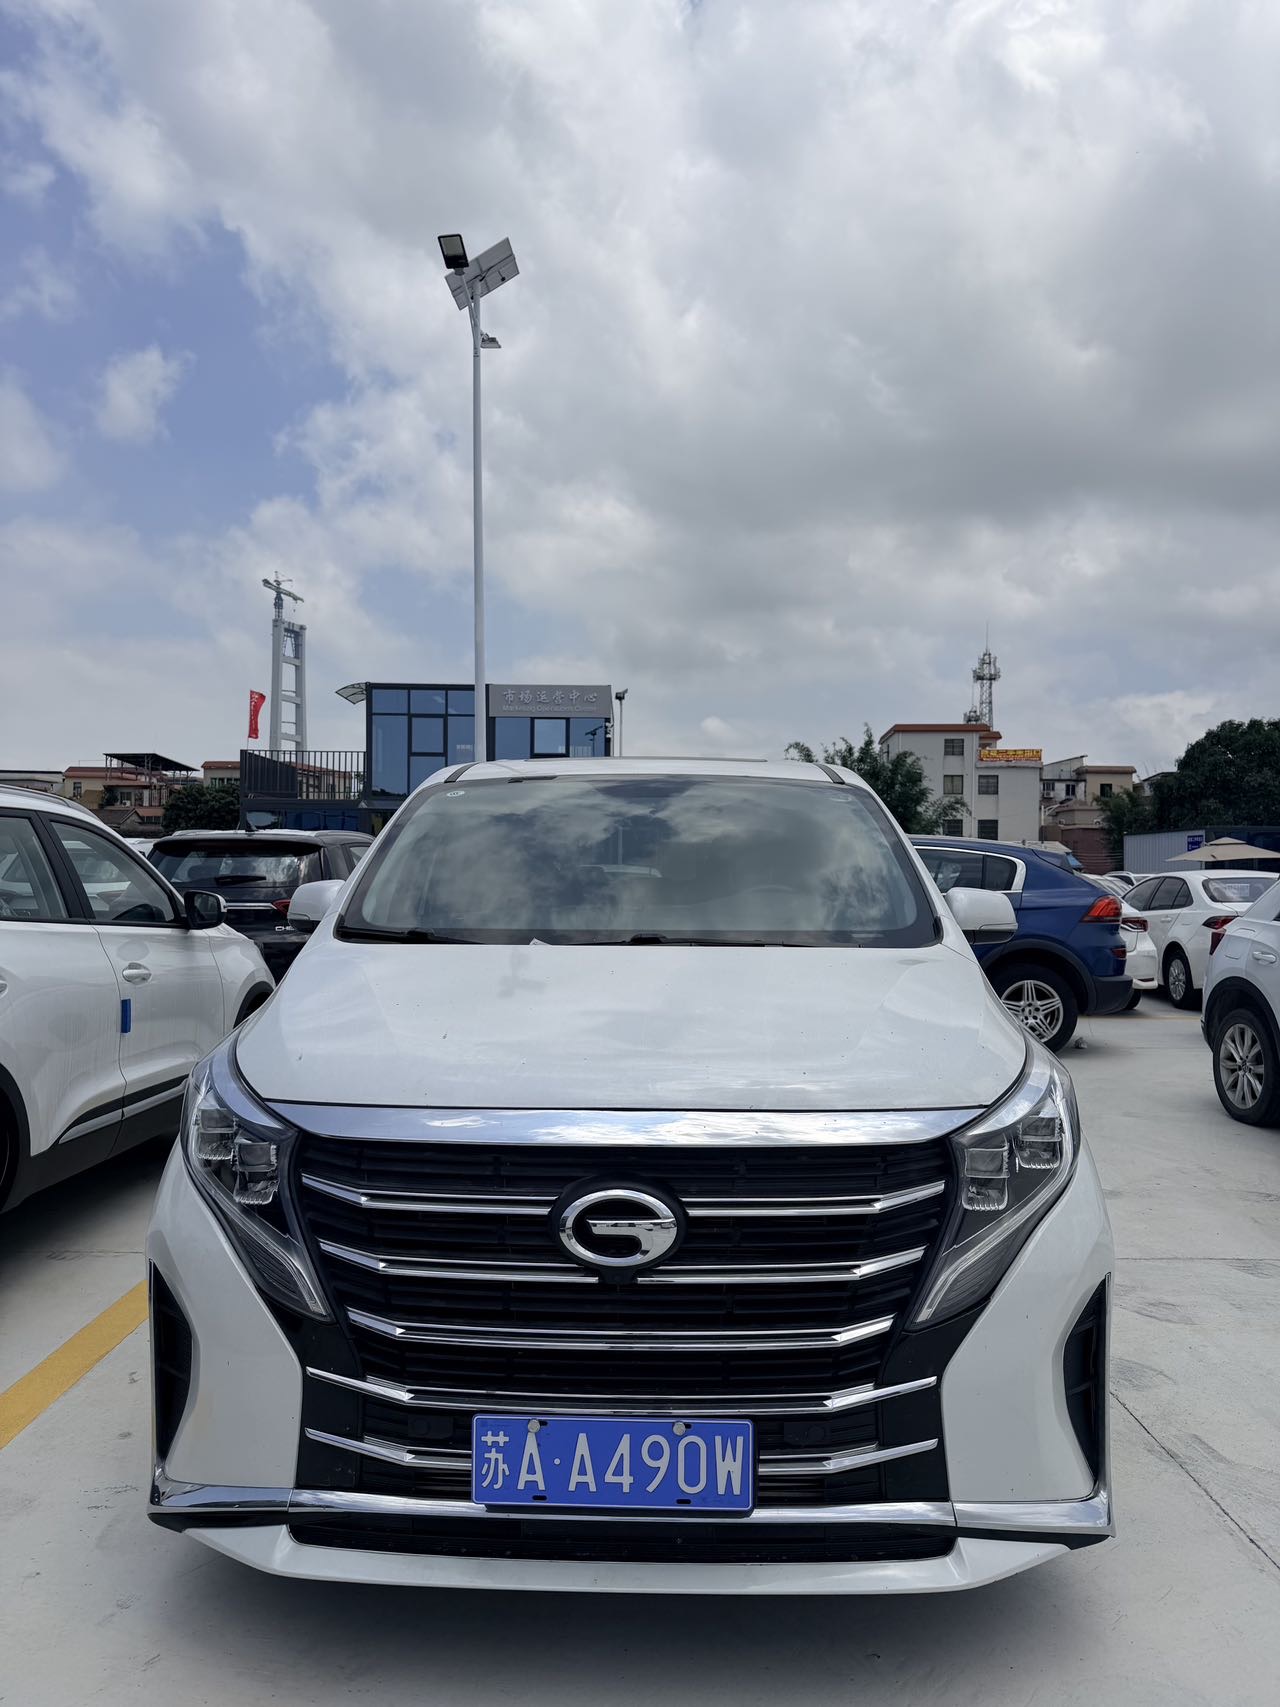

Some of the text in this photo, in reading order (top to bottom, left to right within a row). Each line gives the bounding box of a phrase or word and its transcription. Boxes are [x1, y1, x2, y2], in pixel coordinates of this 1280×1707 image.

[503, 689, 598, 704] 市场运营中心
[480, 1430, 744, 1496] 苏A·A490W
